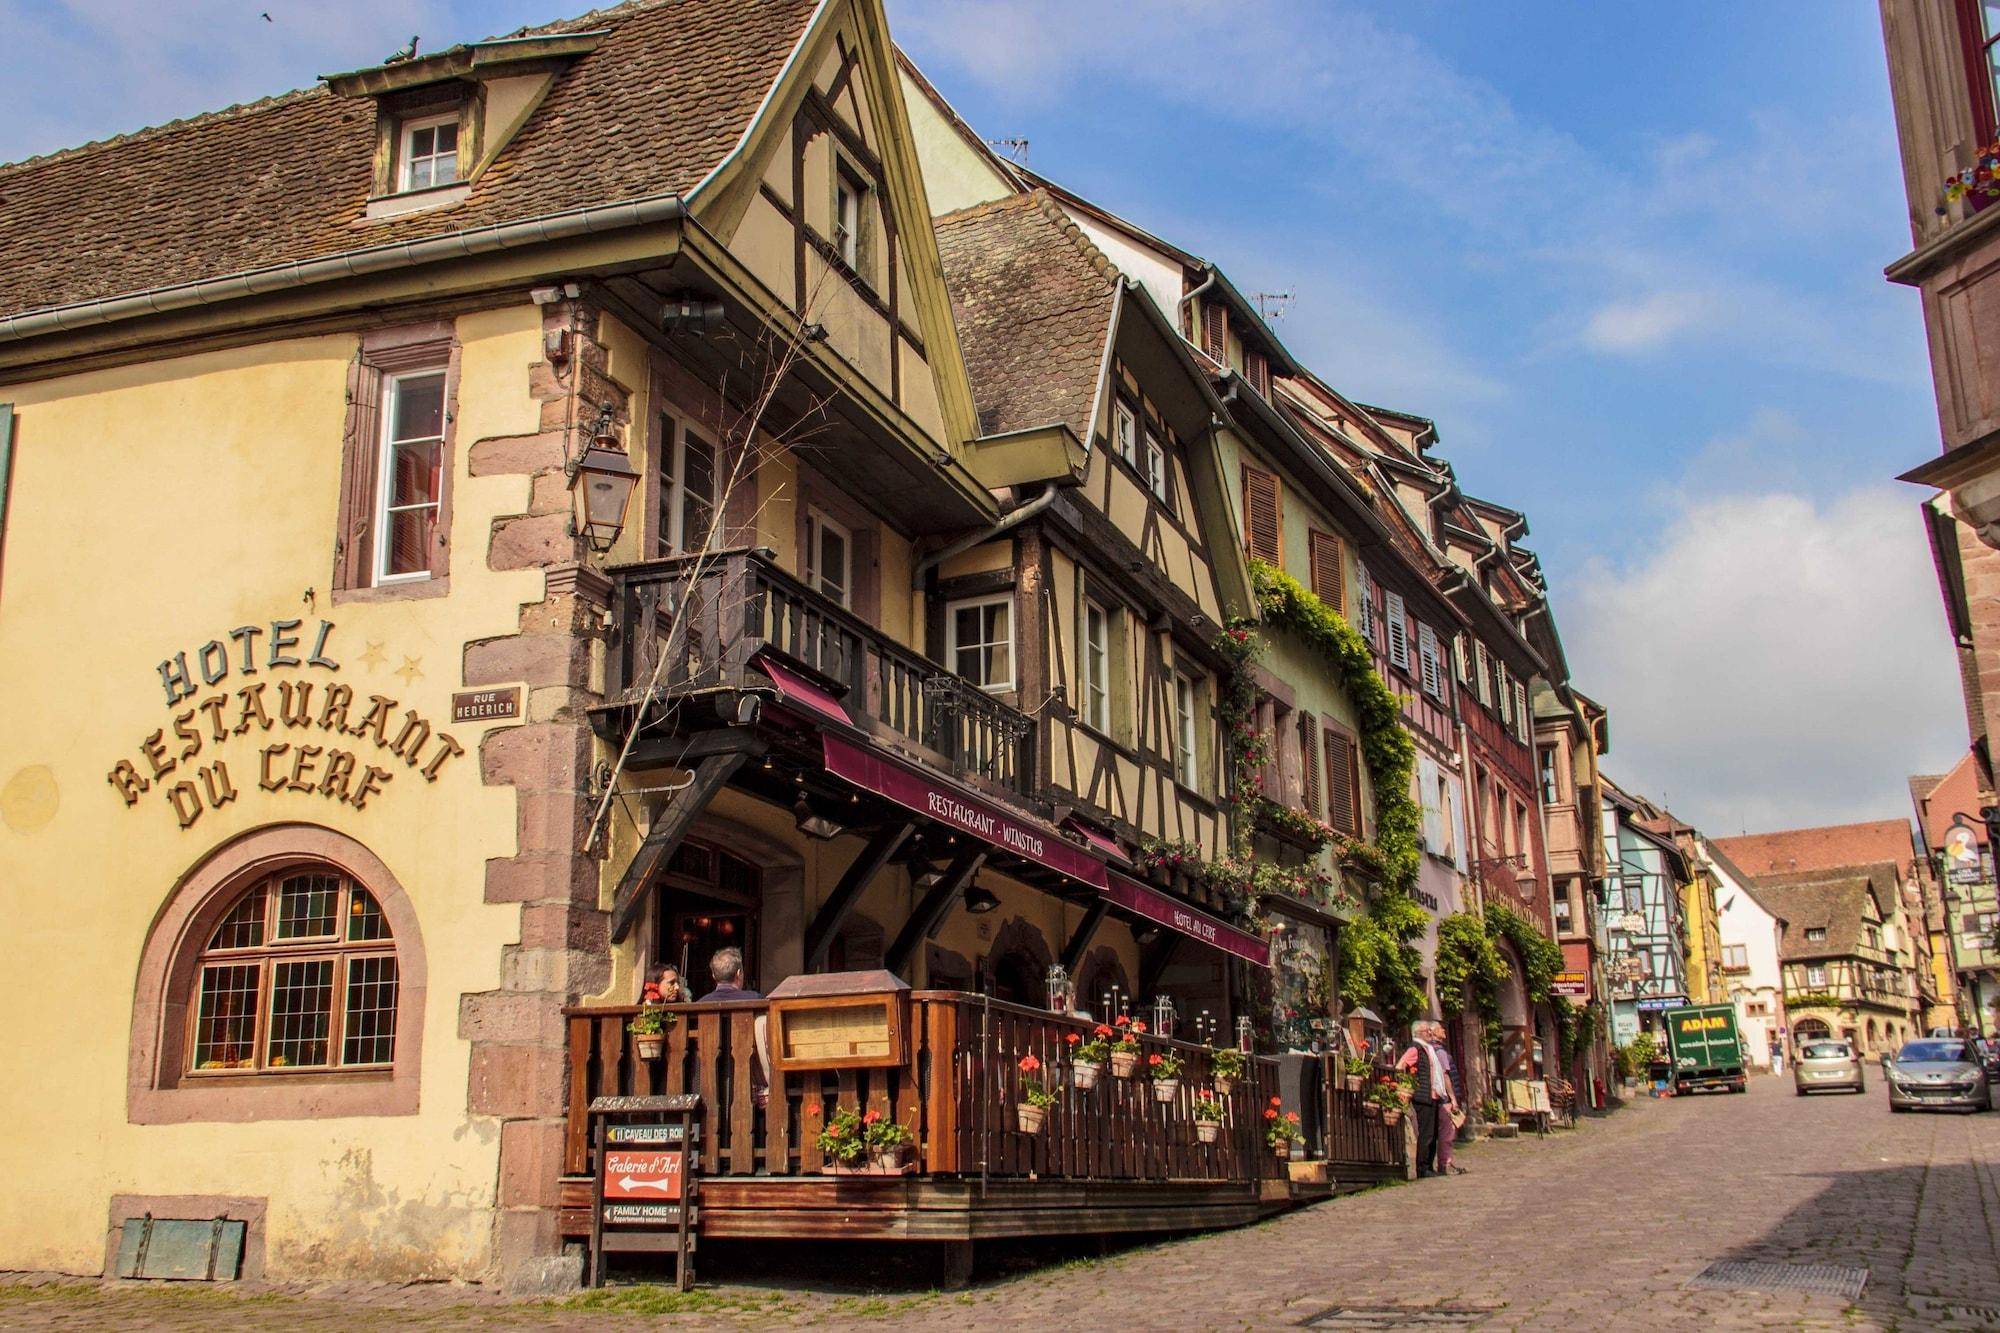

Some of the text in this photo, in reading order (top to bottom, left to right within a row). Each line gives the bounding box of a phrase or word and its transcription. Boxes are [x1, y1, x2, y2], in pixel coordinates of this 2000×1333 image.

[156, 619, 340, 707] HOTEL
[473, 693, 496, 704] RUE
[457, 702, 513, 718] HEDERICH
[108, 680, 464, 808] RESTAURANT
[167, 743, 393, 832] DU CERF
[928, 792, 995, 835] RESTAURANT
[1003, 823, 1043, 857] WINSTUB
[1174, 910, 1192, 931] HOTEL
[1202, 923, 1216, 942] CERF
[1681, 1016, 1728, 1032] ADAM
[625, 1128, 653, 1140] CAVEAU
[654, 1128, 668, 1140] DES
[607, 1155, 681, 1174] Galerie d'Art
[613, 1206, 667, 1216] FAMILY HOME
